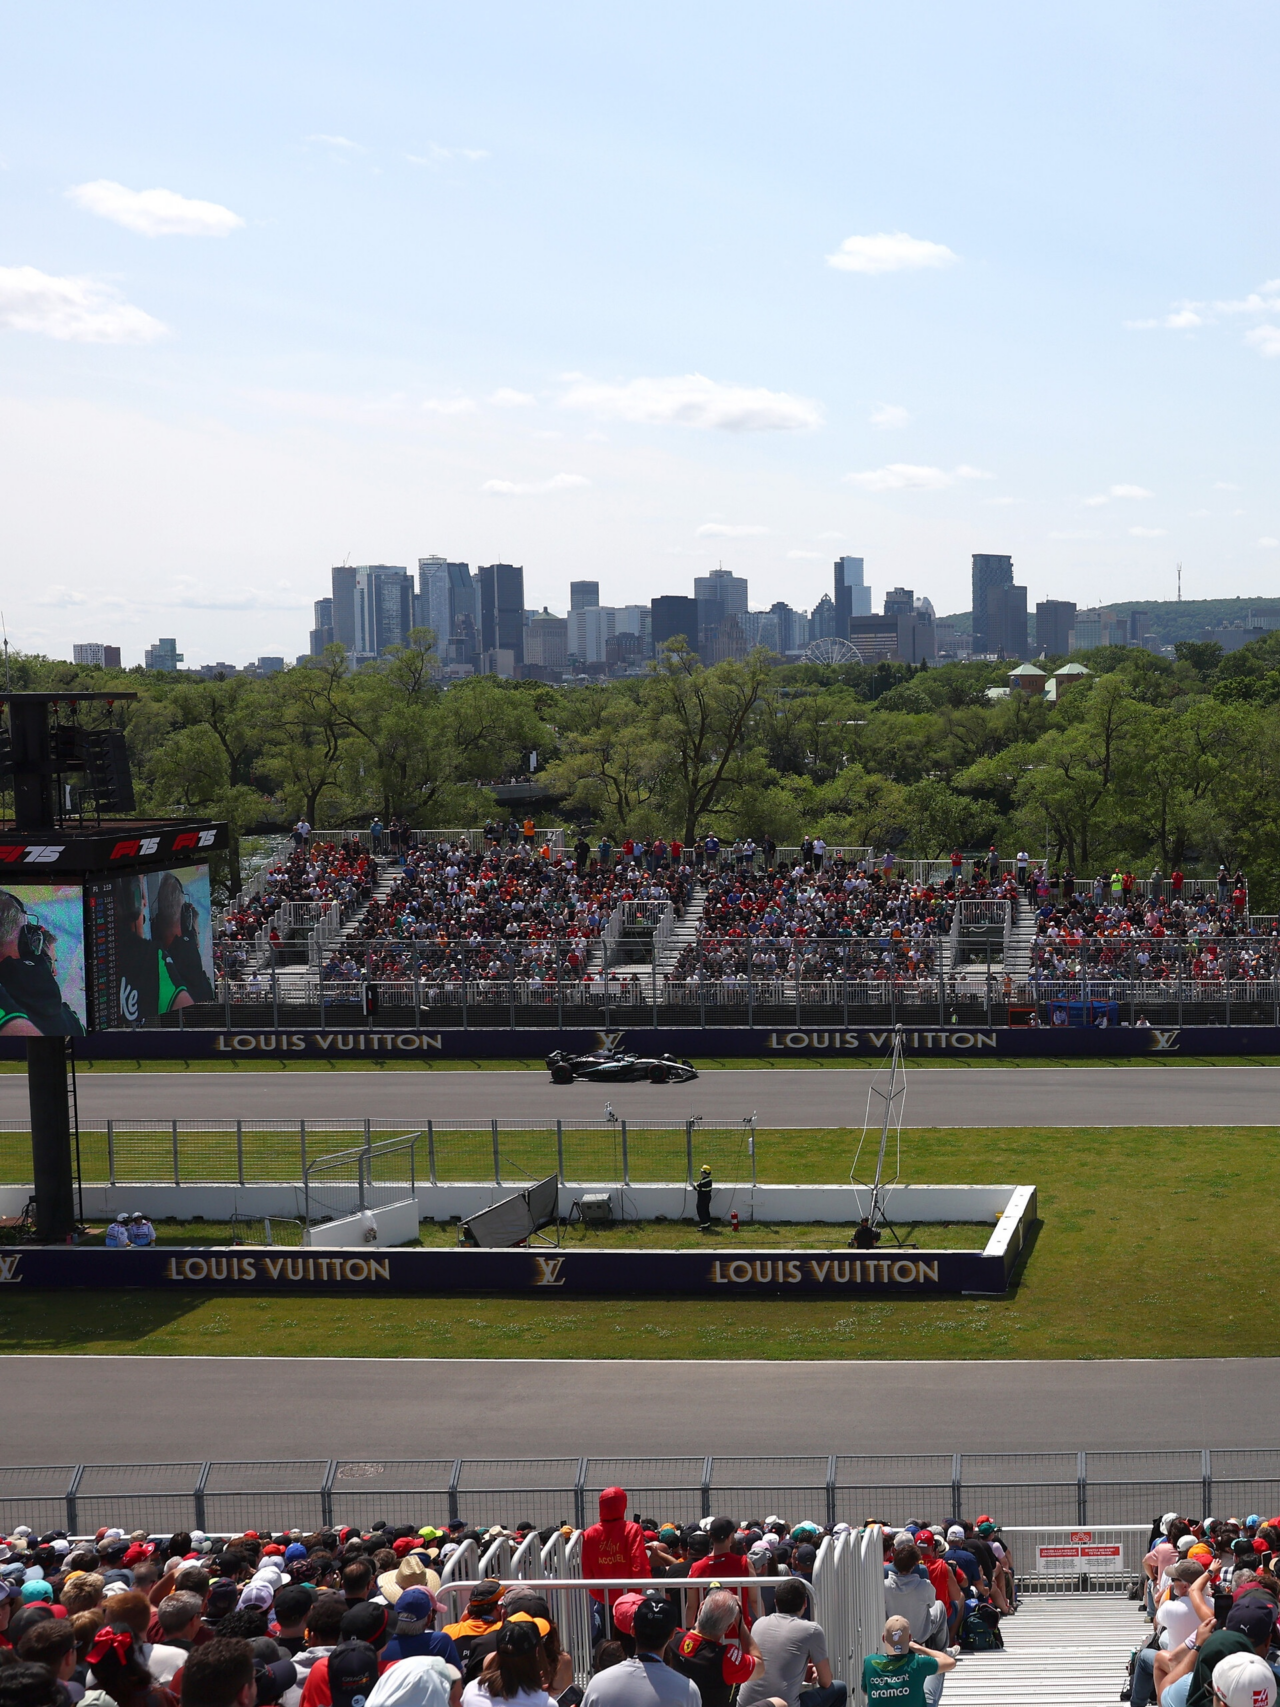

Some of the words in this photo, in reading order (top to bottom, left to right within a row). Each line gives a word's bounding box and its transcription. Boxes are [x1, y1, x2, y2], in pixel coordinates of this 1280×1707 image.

[218, 1034, 306, 1051] LOUIS
[315, 1034, 442, 1050] VUITTON
[771, 1032, 859, 1049] LOUIS
[868, 1032, 997, 1048] VUITTON
[171, 1257, 257, 1280] LOUIS
[265, 1258, 390, 1281] VUITTON
[714, 1260, 802, 1284] LOUIS
[811, 1260, 940, 1283] VUITTON
[870, 1673, 909, 1686] cognizant
[871, 1687, 910, 1698] aramco
